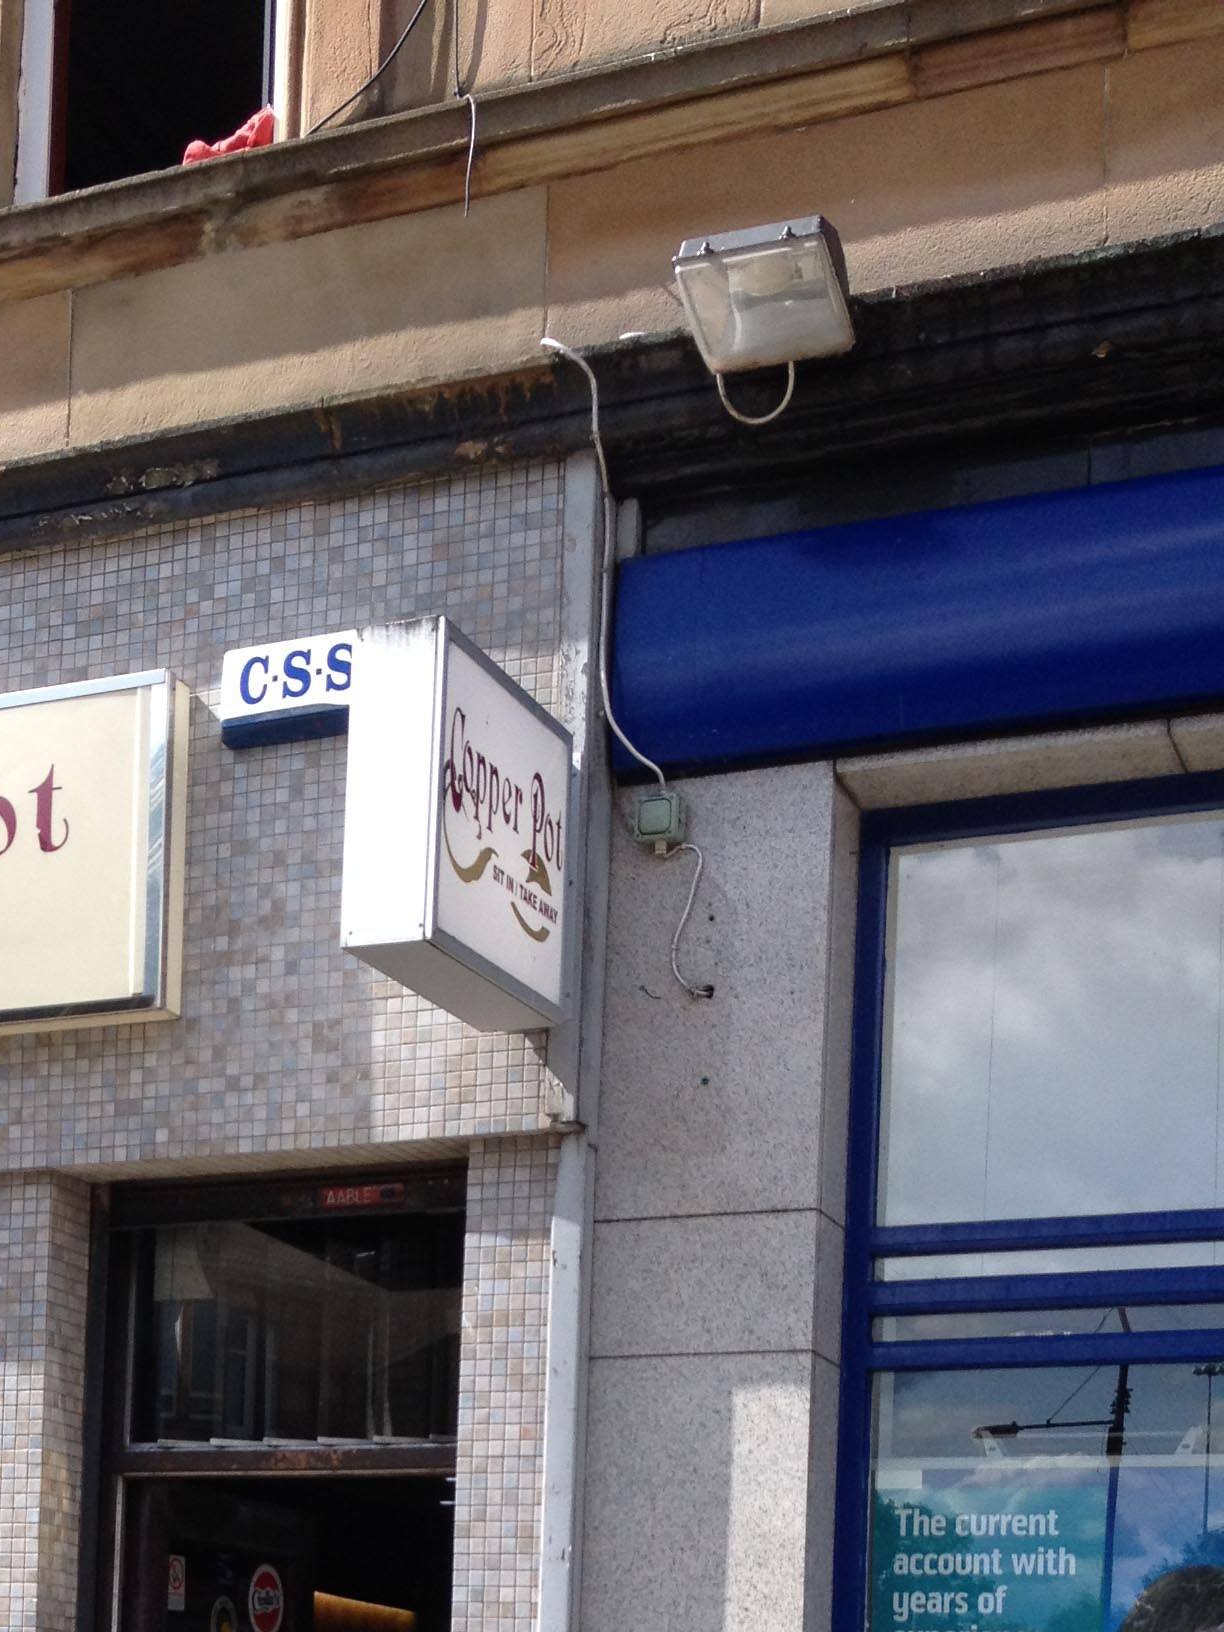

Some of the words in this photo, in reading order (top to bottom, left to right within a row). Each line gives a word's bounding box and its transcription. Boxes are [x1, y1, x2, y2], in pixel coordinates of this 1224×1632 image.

[450, 707, 523, 834] Copper
[531, 772, 563, 871] Pot
[493, 865, 504, 884] SIT
[506, 876, 514, 894] IN
[519, 883, 538, 911] TAKE
[539, 899, 559, 924] AWAY
[895, 1508, 947, 1537] The
[955, 1509, 1060, 1537] current
[893, 1548, 1003, 1576] account
[1012, 1546, 1077, 1576] with
[892, 1590, 969, 1622] years
[977, 1584, 1008, 1615] of
